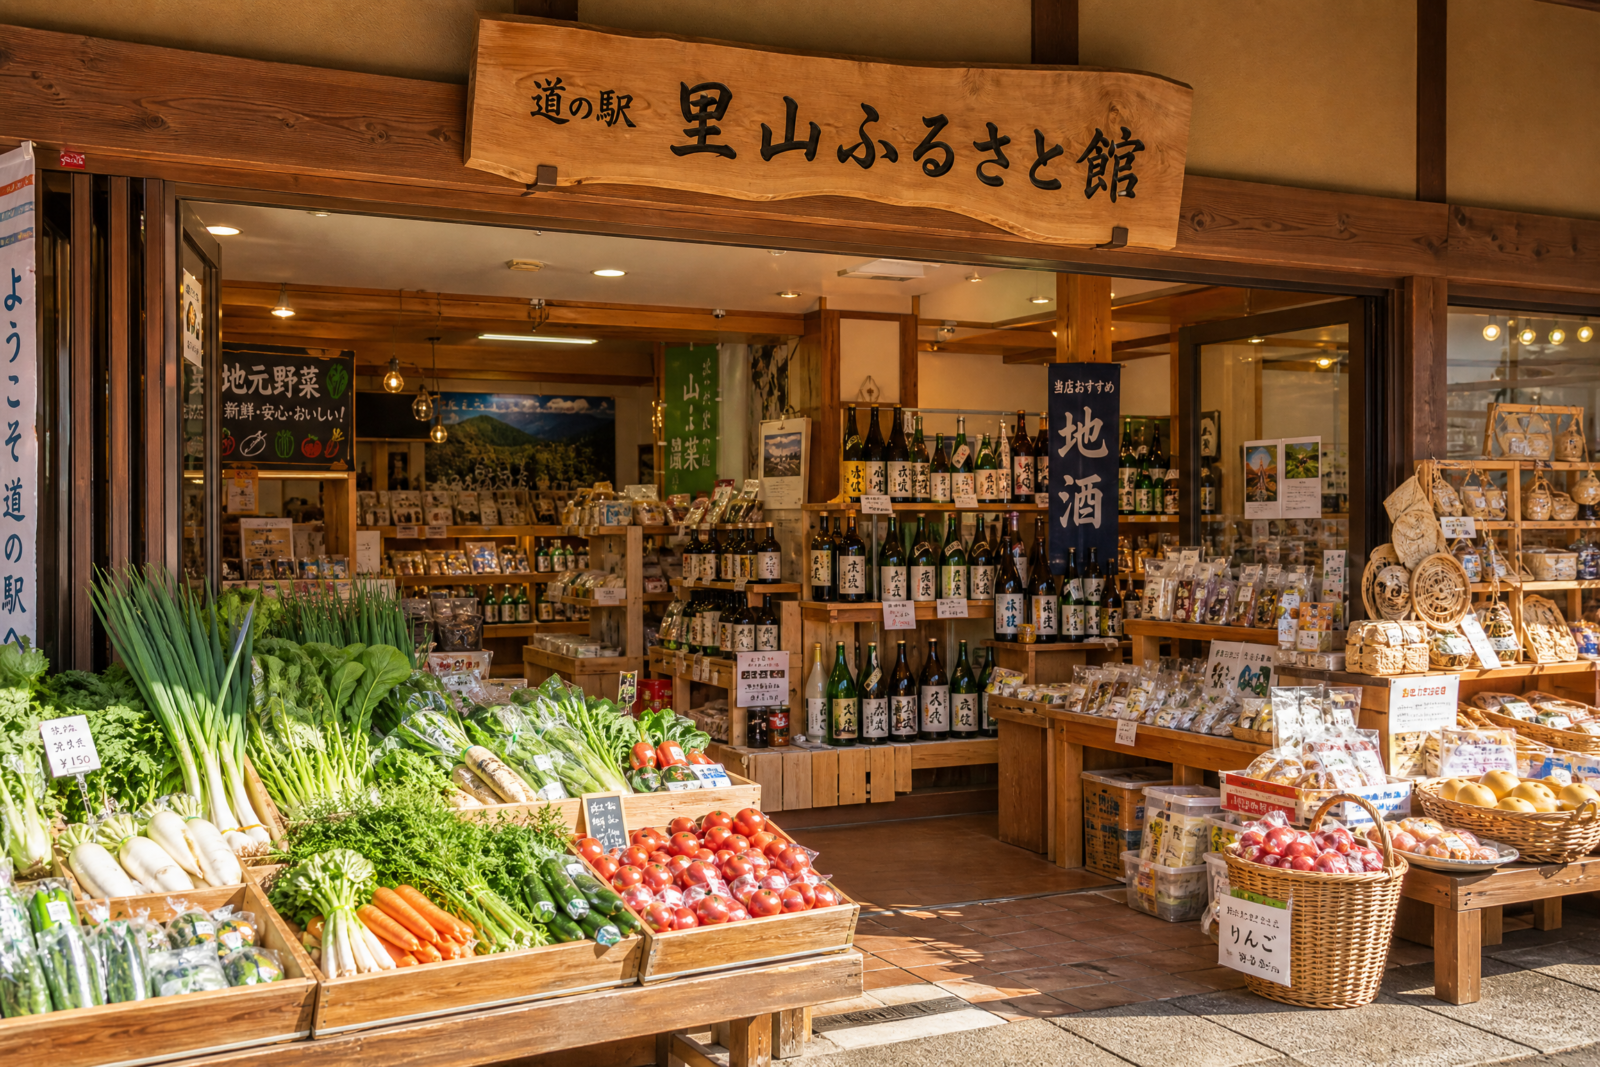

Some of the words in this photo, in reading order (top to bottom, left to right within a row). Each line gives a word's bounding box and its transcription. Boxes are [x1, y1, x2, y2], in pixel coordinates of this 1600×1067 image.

[530, 77, 637, 128] 道の駅
[669, 81, 1146, 203] 里山ふるさと館
[222, 362, 321, 399] 地元野菜
[1054, 379, 1115, 394] 当店おすすめ
[1058, 406, 1109, 529] 地酒
[60, 755, 91, 769] ¥150
[1231, 924, 1276, 953] りんご
